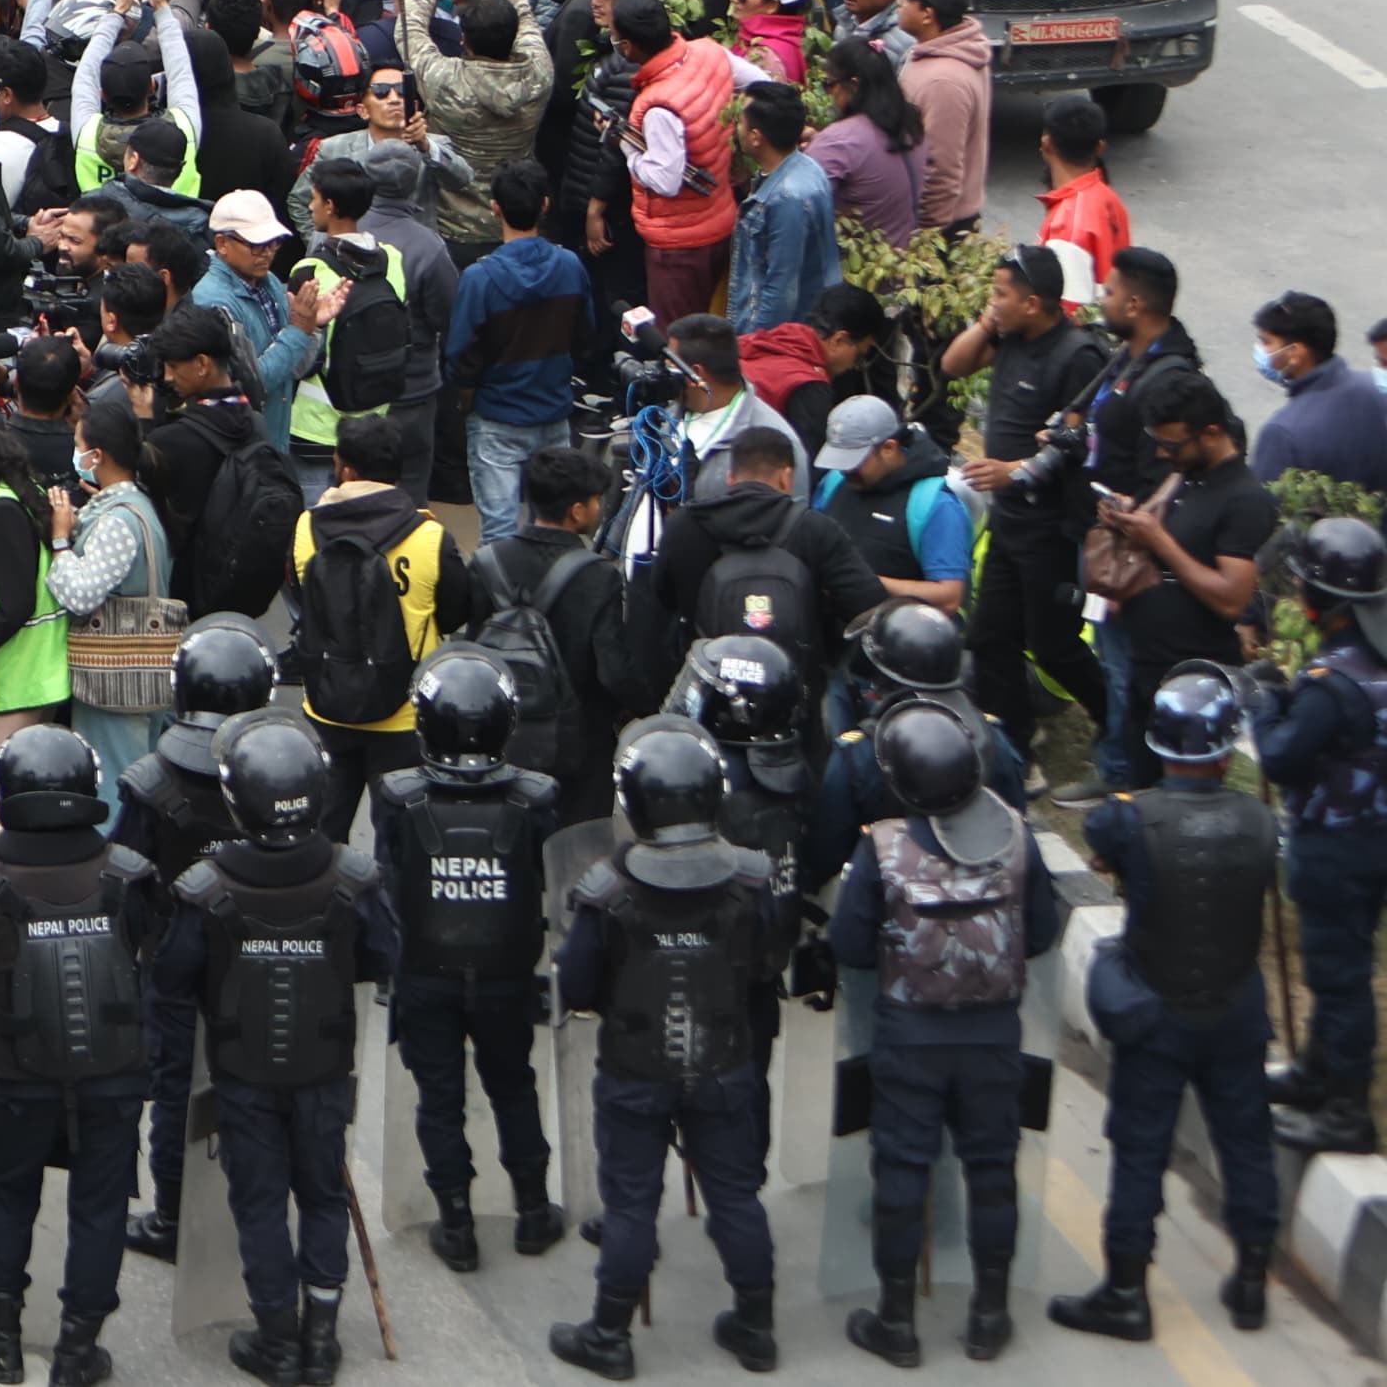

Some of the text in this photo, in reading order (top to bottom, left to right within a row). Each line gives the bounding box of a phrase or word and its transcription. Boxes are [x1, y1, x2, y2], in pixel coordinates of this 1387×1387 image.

[721, 658, 764, 673] NEPAL
[720, 668, 764, 684] POLICE
[274, 796, 308, 812] POLICE
[431, 858, 506, 877] NEPAL
[431, 880, 507, 900] POLICE
[28, 916, 110, 937] NEPAL POLICE
[242, 940, 323, 954] NEPAL POLICE
